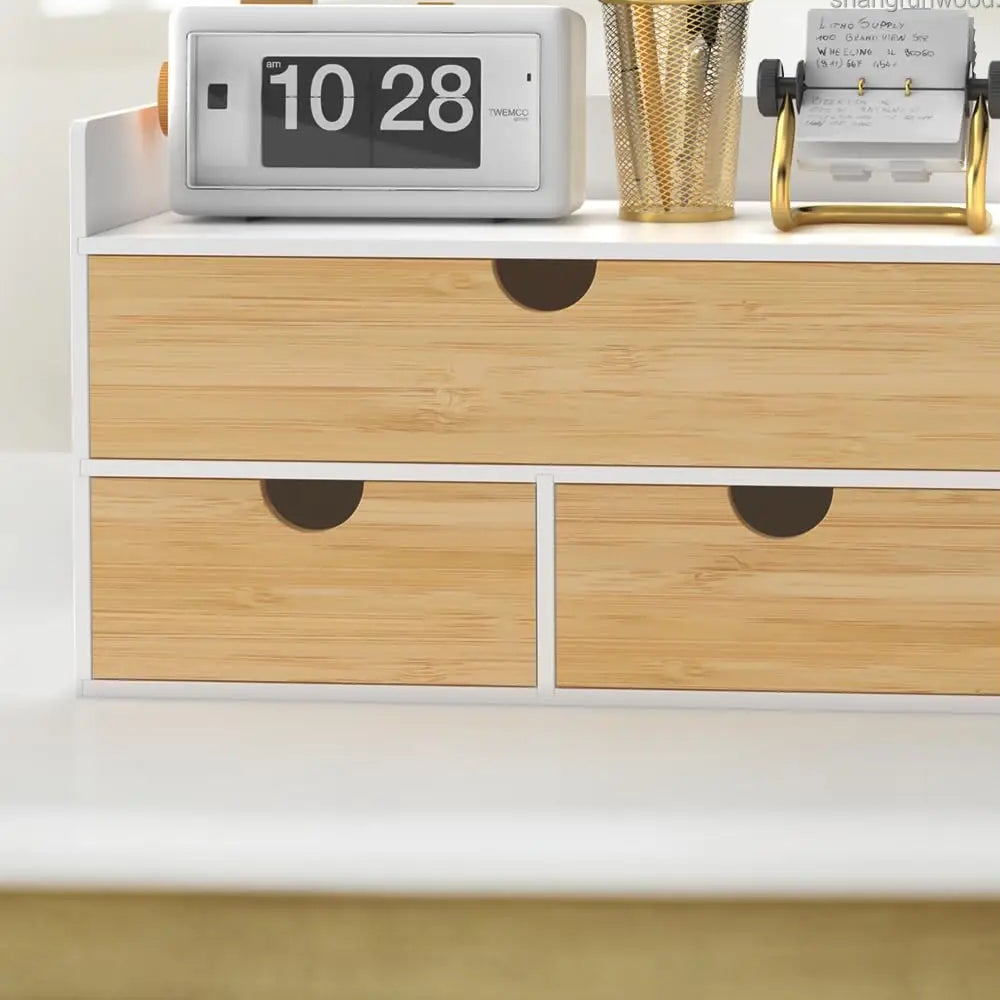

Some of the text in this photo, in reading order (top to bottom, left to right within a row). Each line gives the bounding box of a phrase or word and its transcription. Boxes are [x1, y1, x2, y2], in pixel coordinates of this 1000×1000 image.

[266, 61, 281, 69] am
[270, 63, 474, 133] 10 28
[488, 108, 529, 117] TWEMCO
